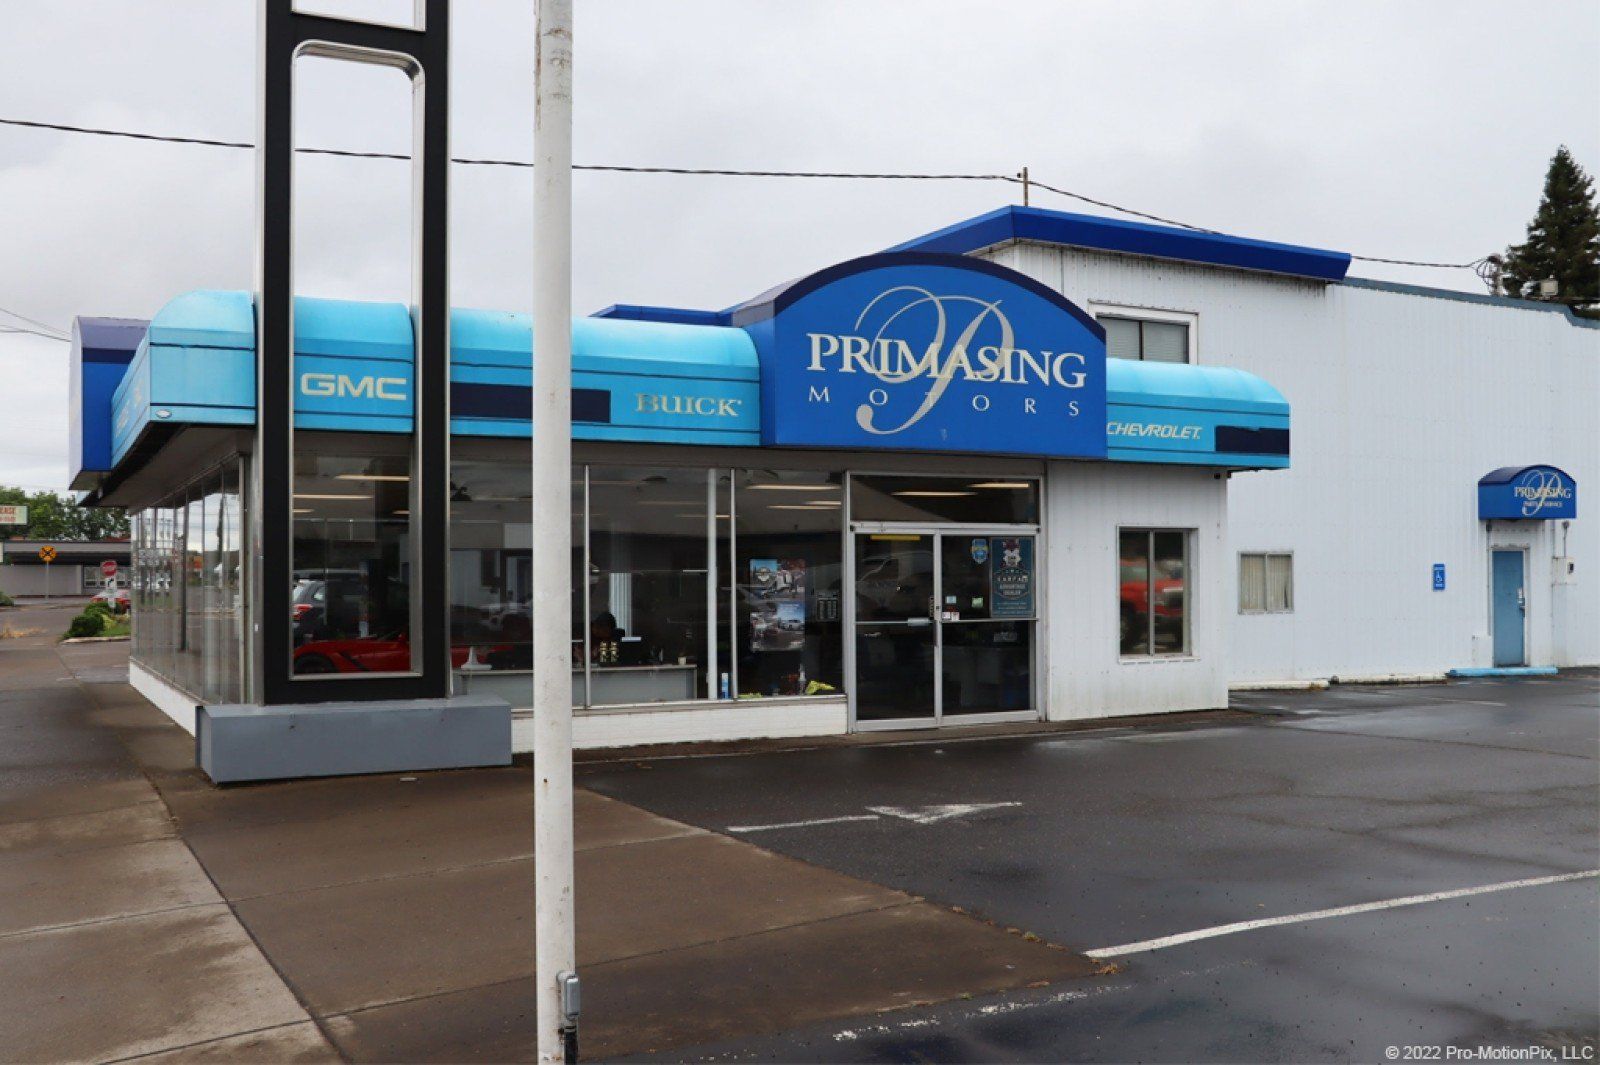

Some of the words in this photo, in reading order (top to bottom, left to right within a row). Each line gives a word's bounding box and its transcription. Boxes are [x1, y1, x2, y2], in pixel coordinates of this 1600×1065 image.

[806, 333, 1087, 388] PRIMASING
[301, 372, 407, 400] GMC
[635, 392, 740, 416] BUICK
[808, 386, 1080, 416] MOTORS
[1106, 421, 1203, 440] CHEVROLET
